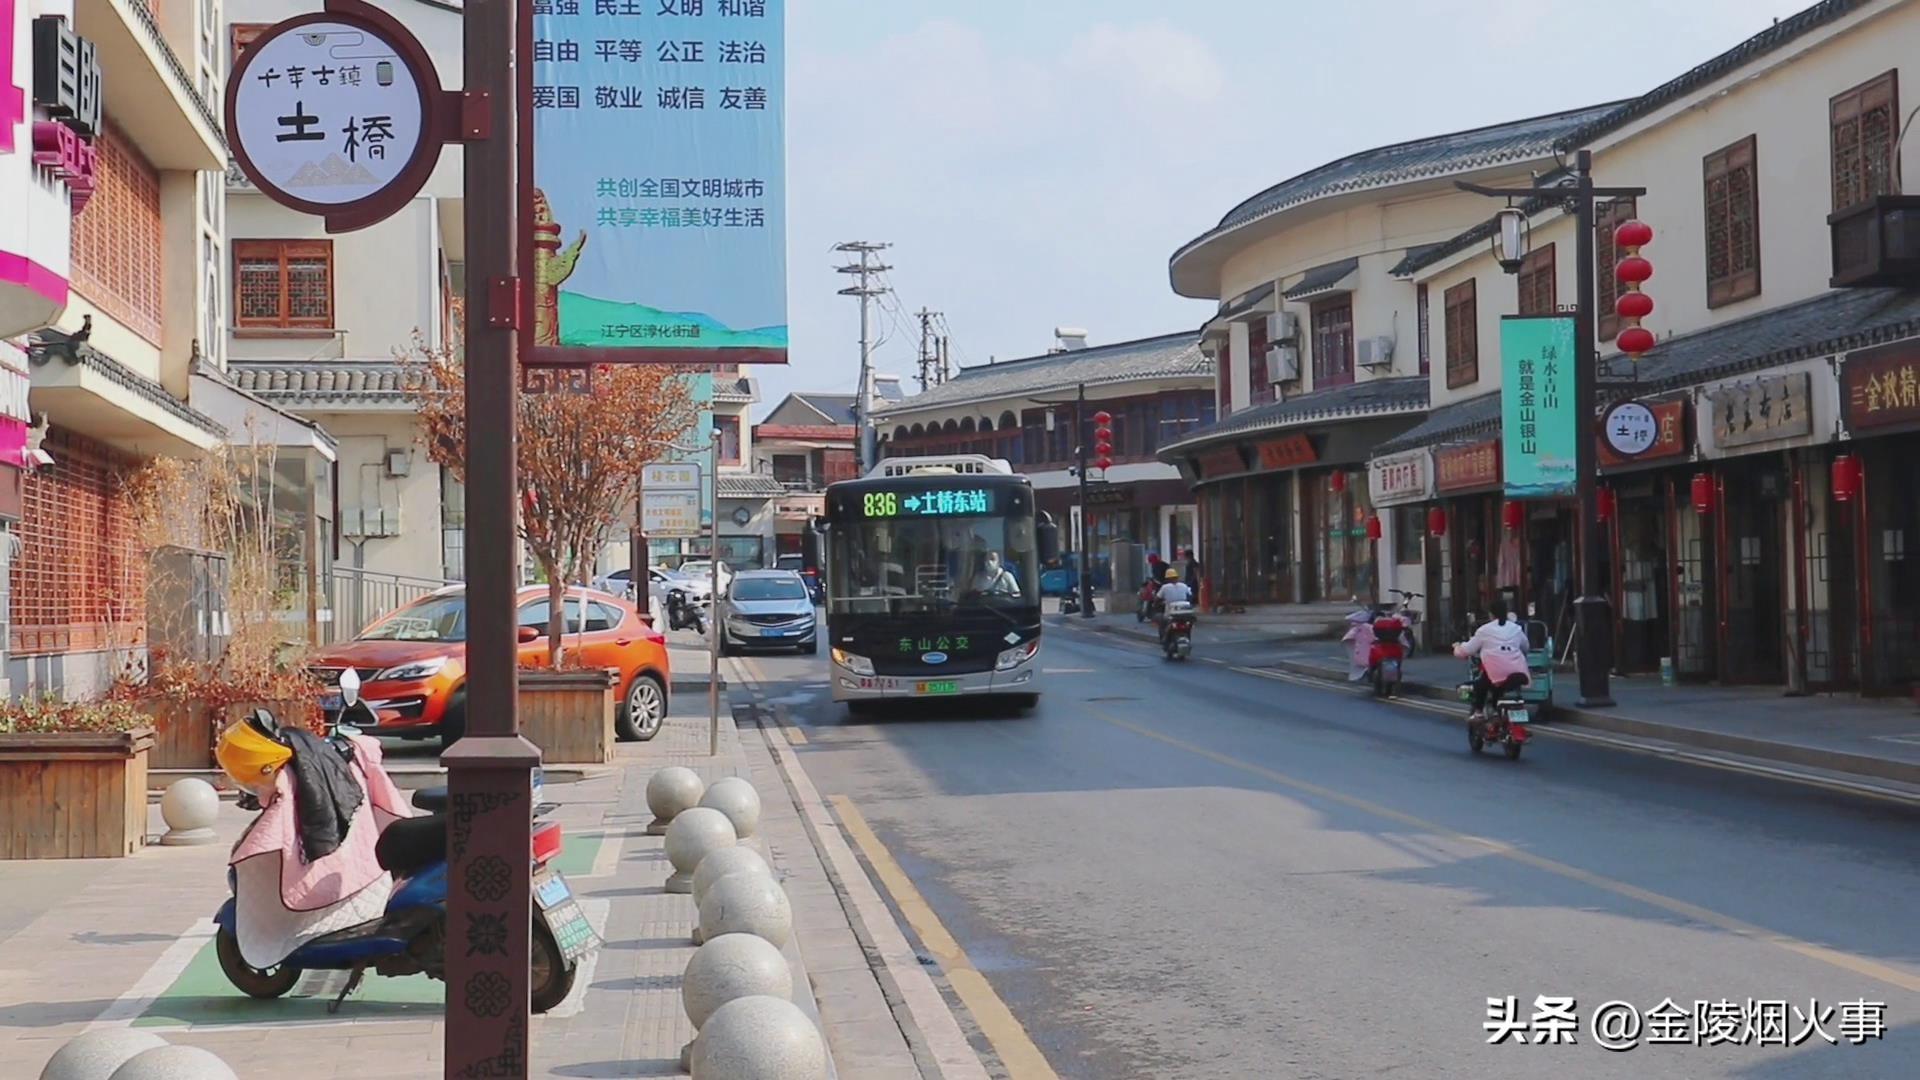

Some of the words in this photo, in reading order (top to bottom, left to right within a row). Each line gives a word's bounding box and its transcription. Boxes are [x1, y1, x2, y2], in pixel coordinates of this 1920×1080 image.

[533, 0, 580, 16] 富强
[595, 0, 641, 16] 民主
[657, 0, 703, 17] 文明
[718, 0, 765, 17] 和谐
[534, 40, 580, 63] 自由
[595, 40, 642, 63] 平等
[657, 40, 704, 63] 公正
[718, 40, 766, 64] 法治
[533, 86, 580, 110] 爱国
[595, 86, 643, 110] 敬业
[657, 86, 705, 110] 诚信
[718, 86, 767, 111] 友善
[596, 178, 764, 199] 共创全国文明城市
[597, 207, 764, 229] 共享幸福美好生活
[601, 324, 701, 339] 江宁区淳化街道
[1518, 359, 1536, 455] 就是金山银山
[863, 492, 897, 517] 836
[920, 489, 986, 514] 土桥东站
[899, 636, 969, 651] 东山公交
